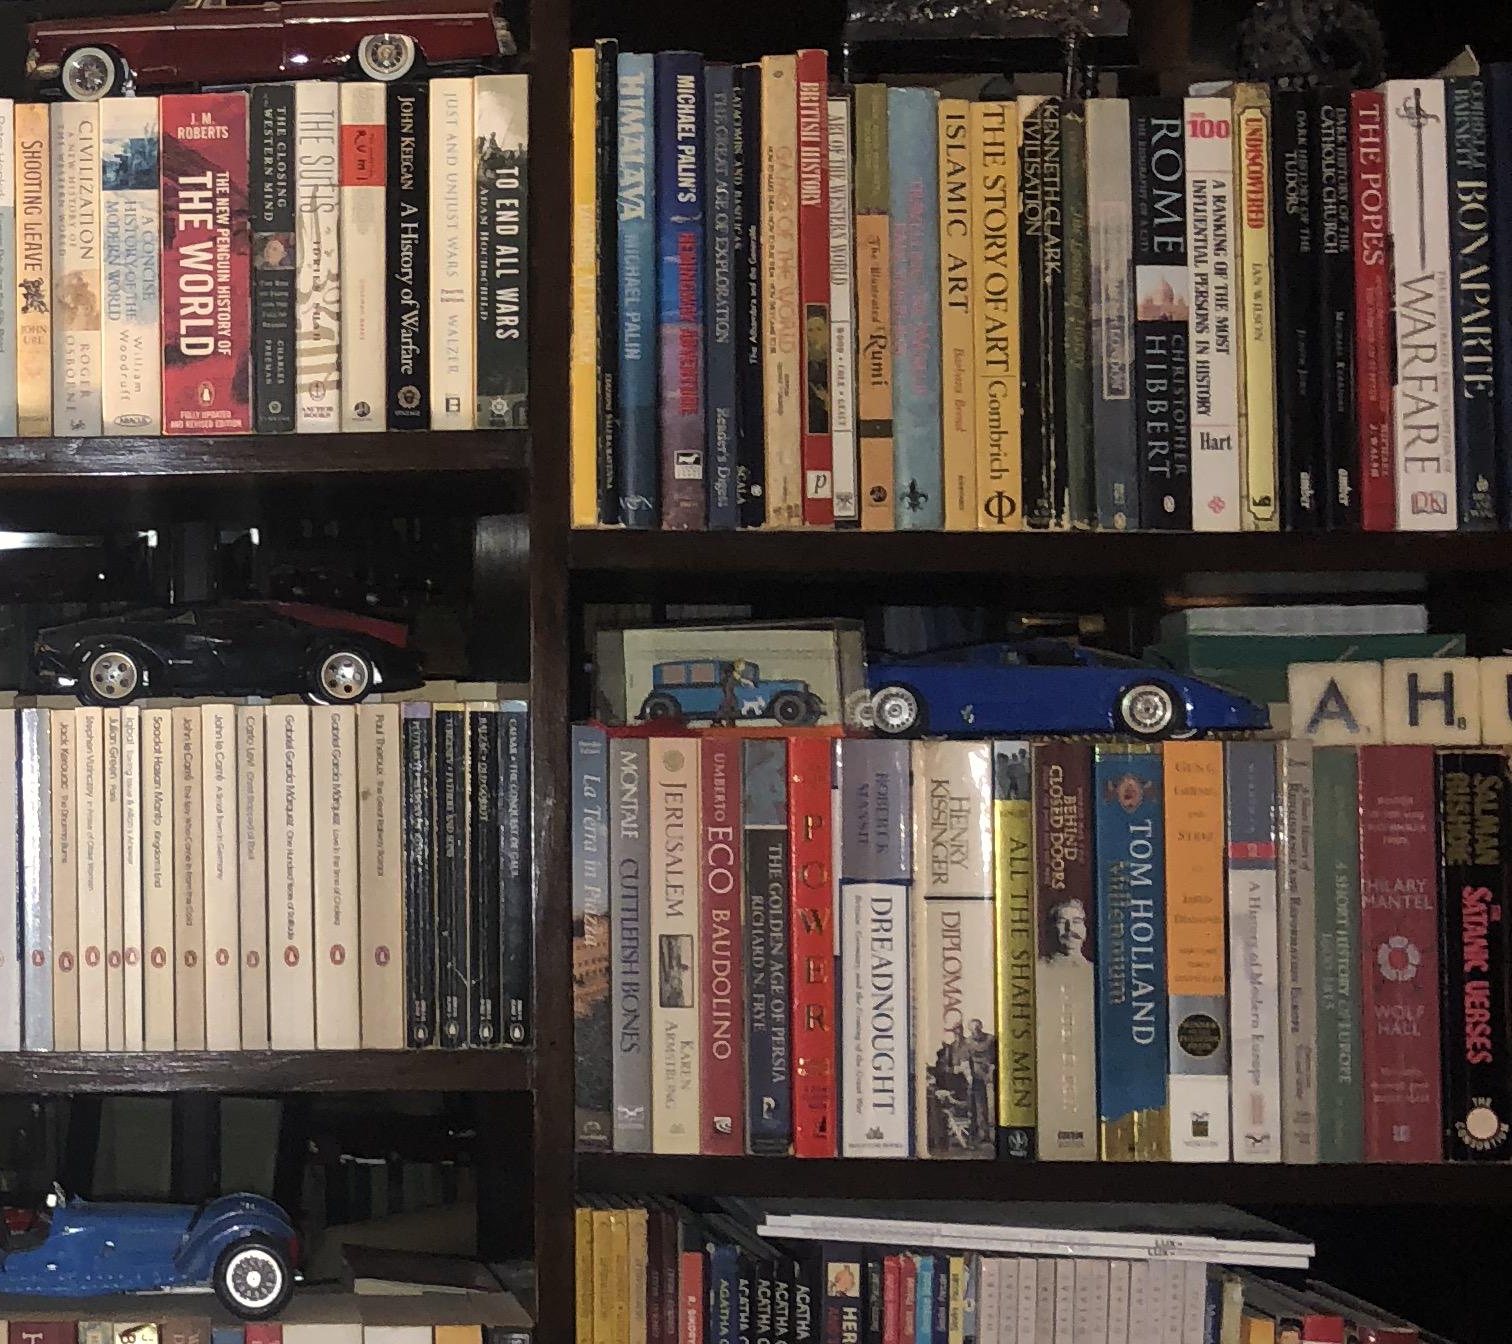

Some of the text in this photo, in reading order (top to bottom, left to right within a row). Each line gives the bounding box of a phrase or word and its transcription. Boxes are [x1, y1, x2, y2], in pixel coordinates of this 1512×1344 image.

[177, 126, 229, 139] ROBERTS
[945, 114, 968, 313] ISLAMIC ART
[1150, 117, 1183, 256] ROME
[1189, 119, 1229, 138] 100
[178, 171, 214, 357] THE WORLD
[395, 201, 422, 376] A History of Warfare
[496, 166, 519, 341] TO END ALL WARS
[983, 105, 1009, 373] THE STORY OF ART
[1456, 181, 1493, 399] BONAPARTE
[1144, 335, 1171, 478] HIBBERT
[1200, 432, 1232, 451] Hart
[1399, 274, 1440, 474] WARFARE
[660, 781, 686, 919] JERUSALEM
[930, 778, 950, 885] KISSINGER
[950, 794, 969, 872] HENRY
[707, 827, 733, 1060] ECO BAUDOLINO
[870, 896, 896, 1115] DREADNOUGHT
[1129, 819, 1155, 1046] TOM HOLLAND
